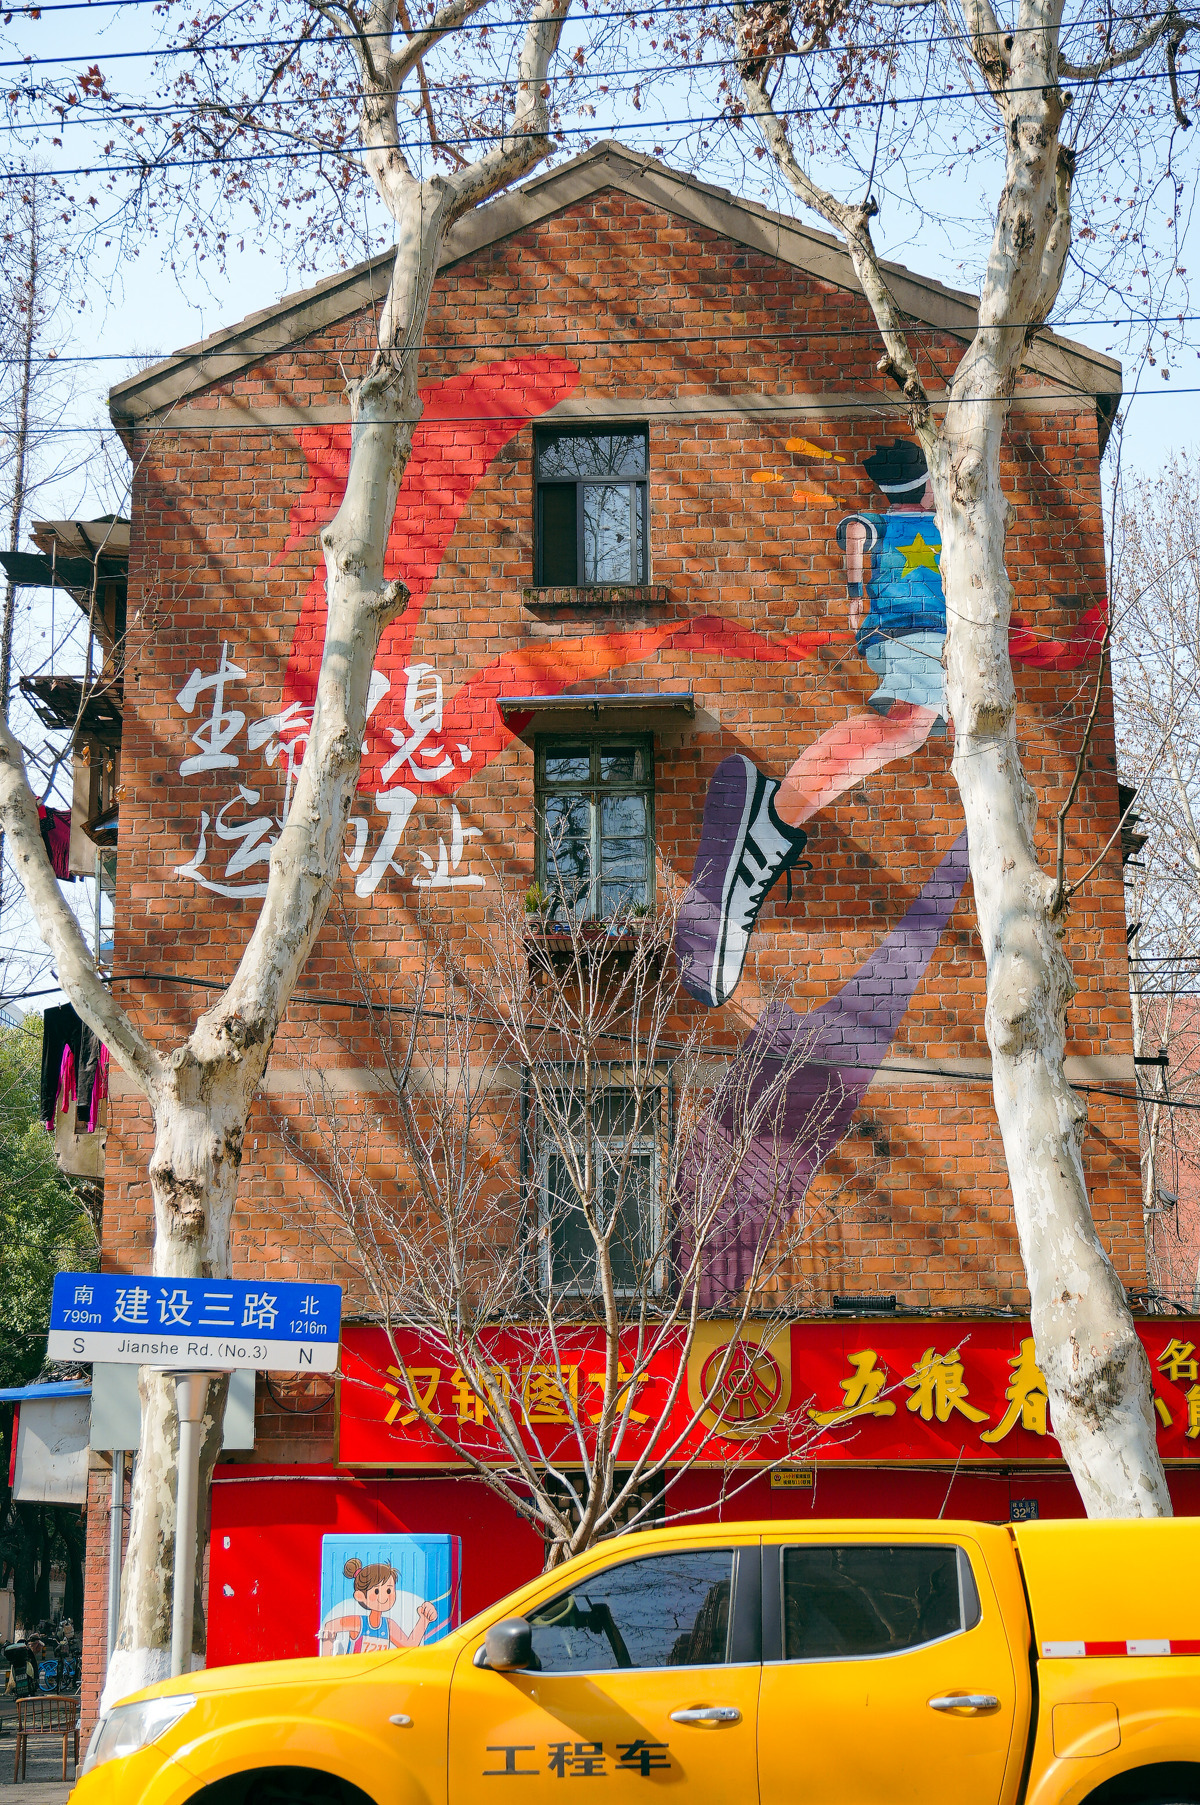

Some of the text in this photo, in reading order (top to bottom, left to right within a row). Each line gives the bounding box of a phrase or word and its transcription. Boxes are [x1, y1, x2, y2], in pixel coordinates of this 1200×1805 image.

[74, 1284, 94, 1305] 南
[112, 1286, 279, 1330] 建设三路
[299, 1295, 320, 1316] 北
[62, 1309, 102, 1324] 799m
[288, 1320, 328, 1335] 1216m
[72, 1337, 86, 1354] S
[117, 1339, 179, 1355] Jianshe
[298, 1348, 314, 1365] N
[482, 1739, 672, 1779] 工程车
